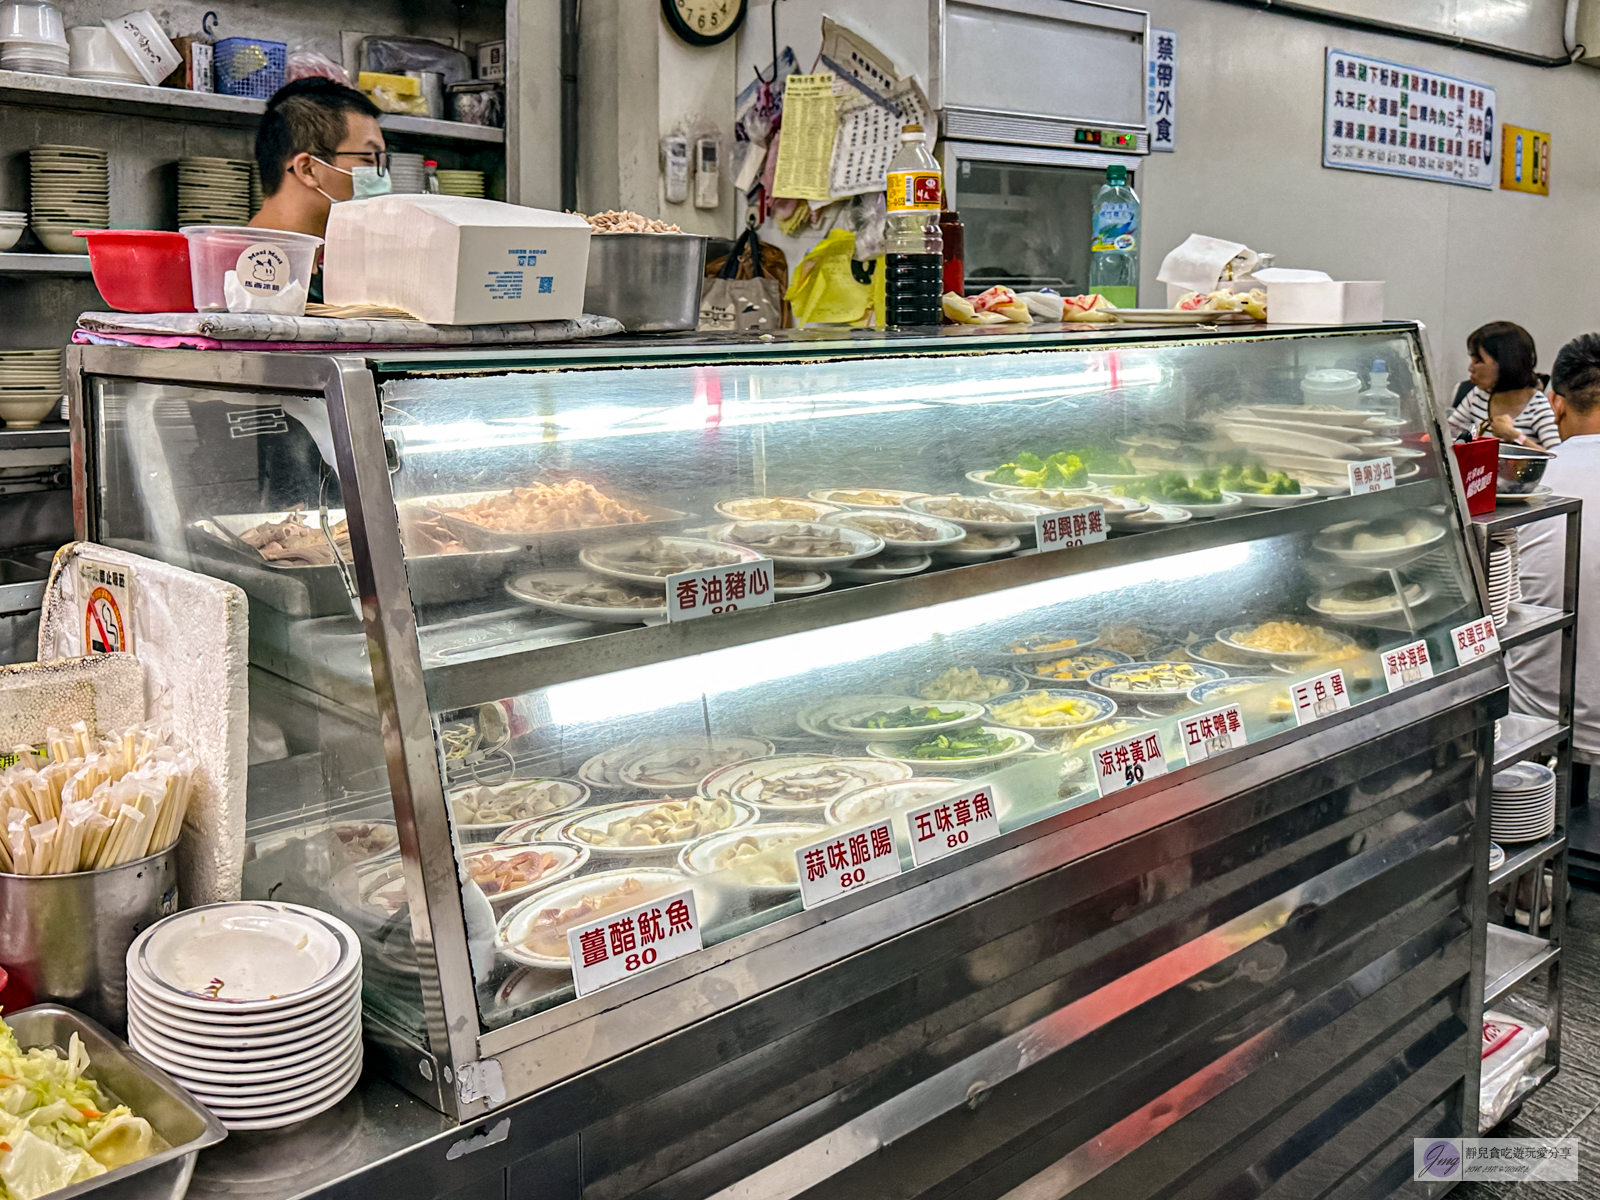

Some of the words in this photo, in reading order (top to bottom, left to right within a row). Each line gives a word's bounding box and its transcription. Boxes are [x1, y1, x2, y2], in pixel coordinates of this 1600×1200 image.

[687, 8, 693, 21] 7
[698, 15, 705, 28] 6
[711, 13, 718, 26] 5
[720, 4, 727, 15] 4
[1156, 36, 1174, 142] 禁帶外食
[1354, 462, 1392, 486] 魚卵沙拉
[1042, 510, 1103, 543] 紹興醉雞
[676, 567, 769, 610] 香油豬心
[1457, 621, 1495, 650] 皮蛋豆腐
[1474, 644, 1485, 655] 50
[1297, 674, 1345, 709] 三色蛋
[1186, 709, 1241, 745] 五味鴨掌
[1099, 734, 1161, 777] 涼拌黃瓜
[915, 792, 993, 842] 五味章魚
[804, 825, 892, 882] 蒜味脆腸
[947, 830, 969, 848] 80
[840, 868, 866, 888] 80
[579, 899, 693, 968] 薑醋魷魚
[625, 948, 657, 971] 80
